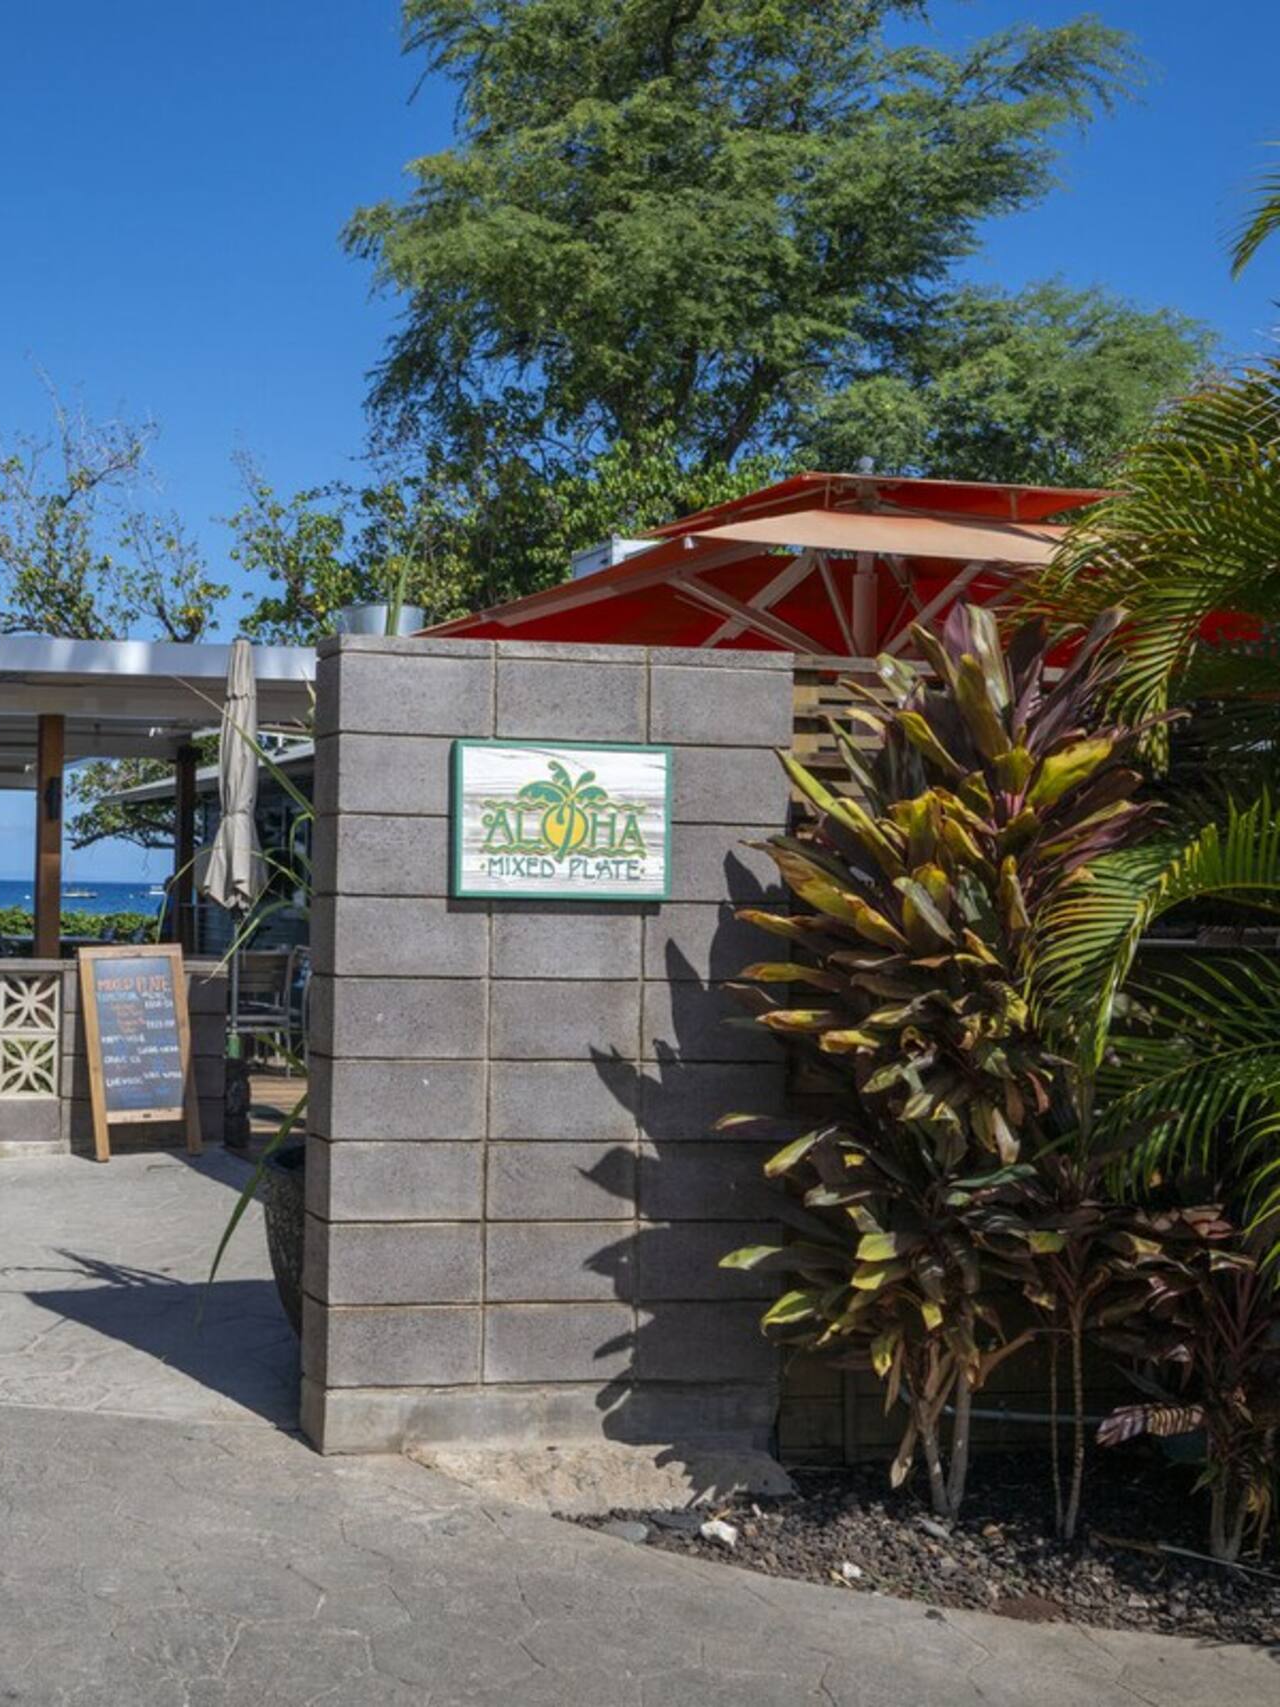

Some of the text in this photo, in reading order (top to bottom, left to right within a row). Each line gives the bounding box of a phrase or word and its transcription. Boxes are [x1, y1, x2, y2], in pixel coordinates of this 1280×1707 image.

[482, 805, 646, 850] ALOHA
[487, 857, 641, 881] MIXED PLATE
